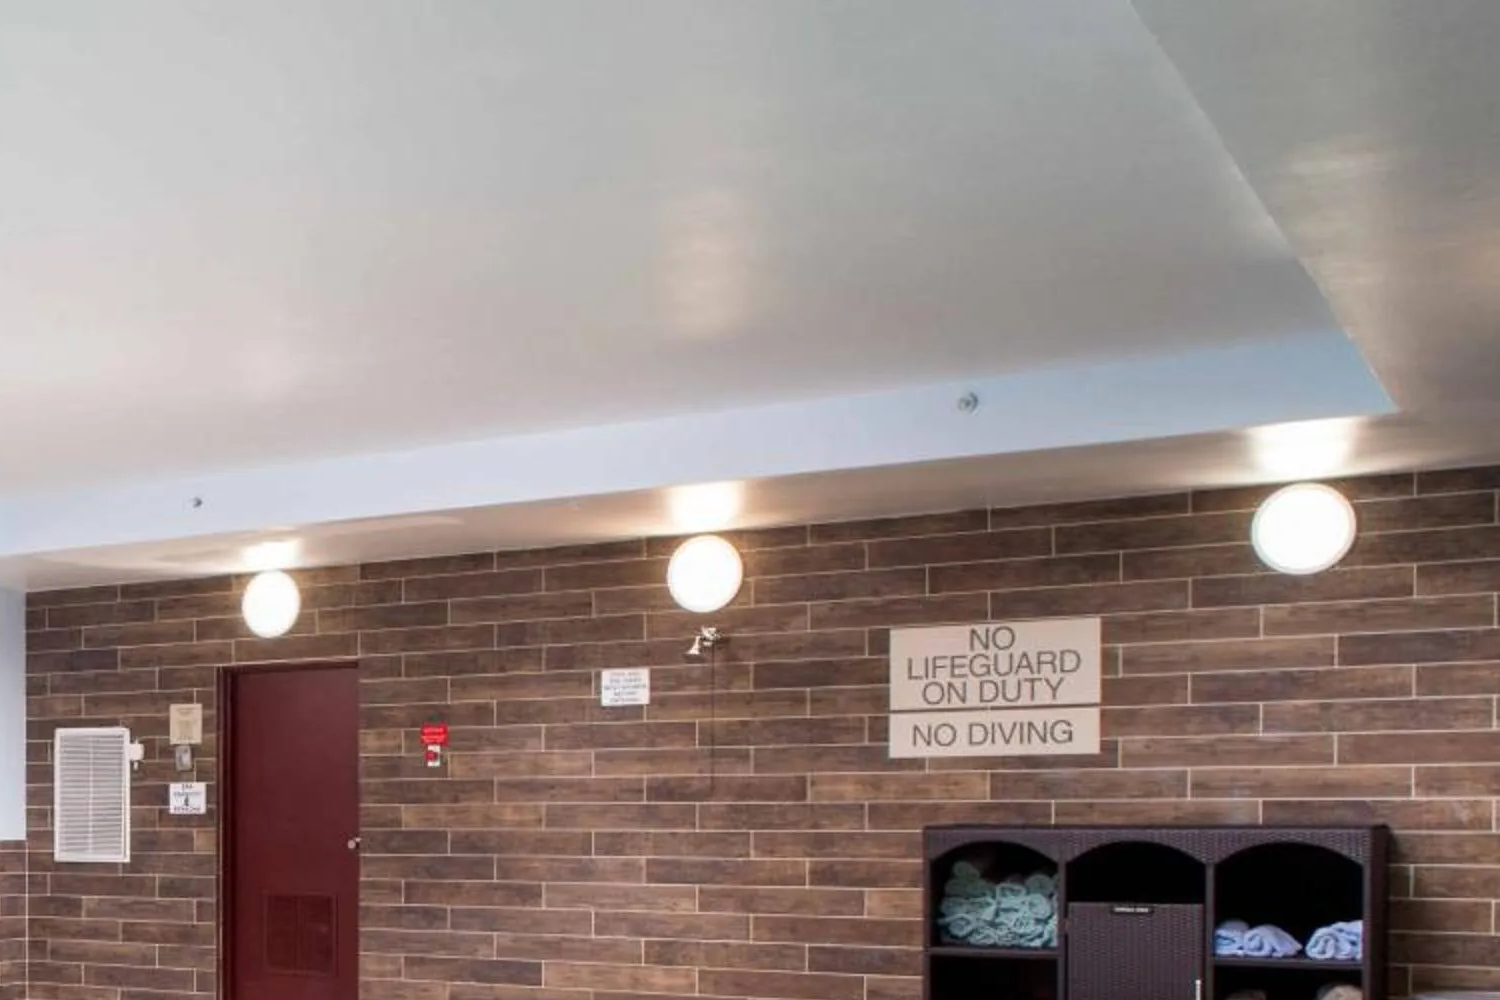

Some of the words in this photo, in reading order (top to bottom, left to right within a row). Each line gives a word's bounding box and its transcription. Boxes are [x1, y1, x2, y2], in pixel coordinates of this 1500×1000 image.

[969, 626, 1016, 651] NO
[907, 649, 1081, 681] LIFEGUARD
[922, 681, 967, 705] ON
[979, 677, 1065, 703] DUTY
[912, 722, 957, 747] NO
[968, 719, 1073, 746] DIVING
